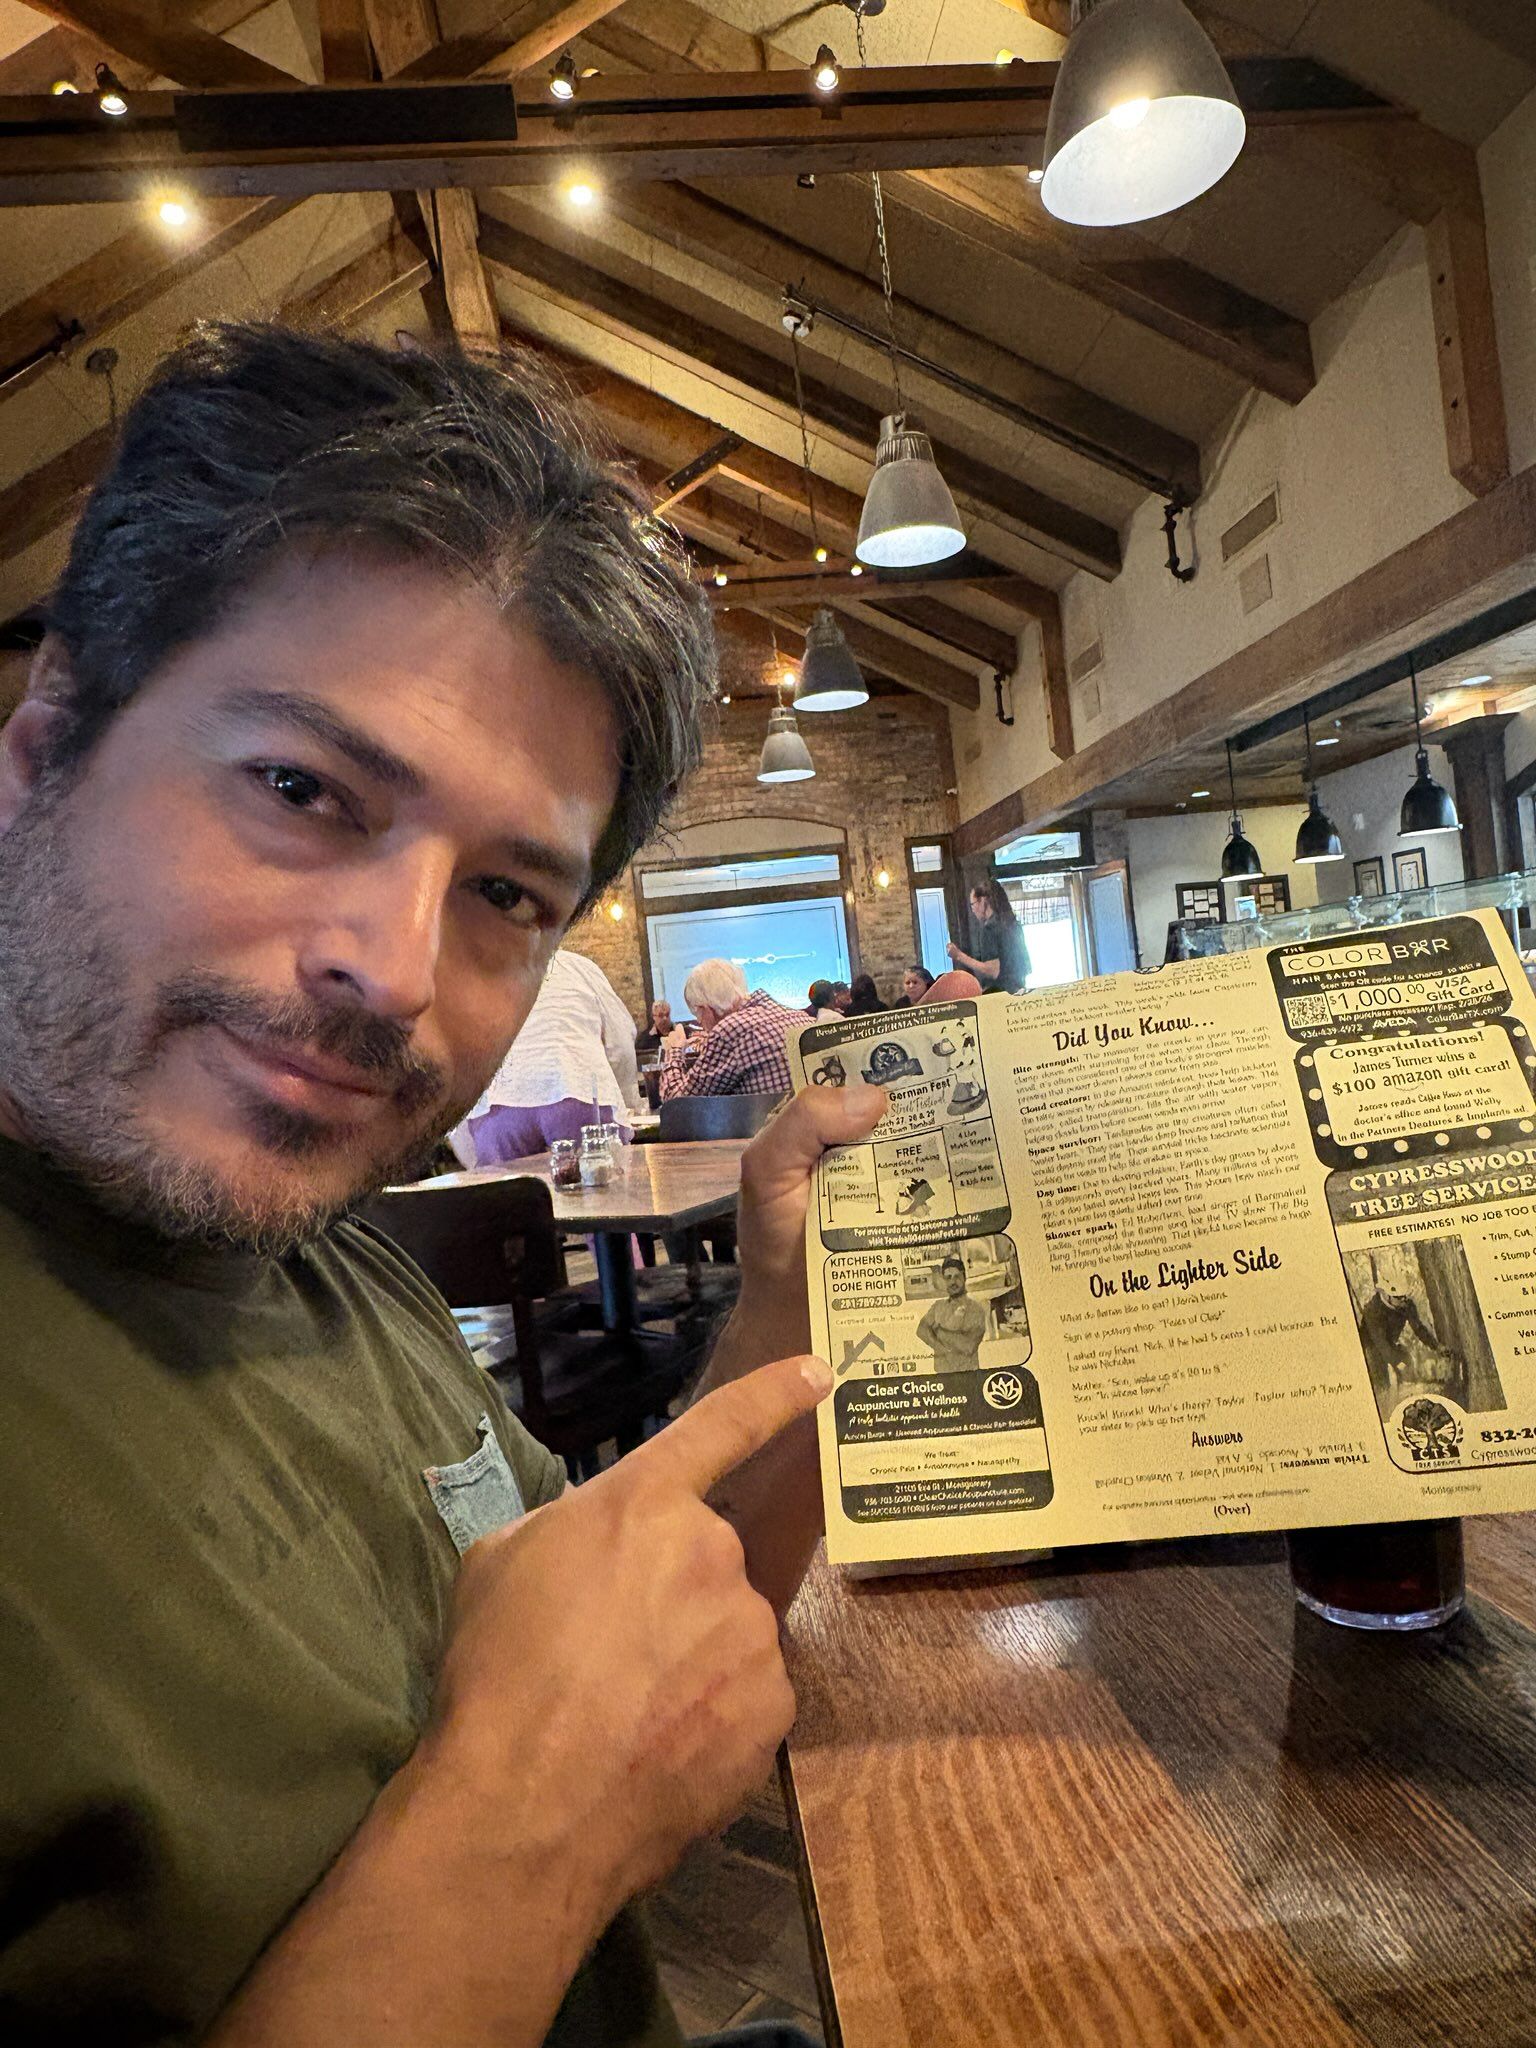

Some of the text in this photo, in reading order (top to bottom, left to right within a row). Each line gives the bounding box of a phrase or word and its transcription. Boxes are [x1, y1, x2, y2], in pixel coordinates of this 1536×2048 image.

[1283, 946, 1305, 955] THE
[1288, 947, 1383, 971] COLOR
[1292, 969, 1366, 985] HAIR SALON
[1320, 981, 1340, 990] Scan
[1356, 977, 1370, 985] QR
[1371, 975, 1392, 984] code
[1435, 975, 1471, 989] VISA
[1426, 980, 1495, 1001] Gift Card
[1338, 1013, 1352, 1022] No
[1354, 1009, 1391, 1022] purchase
[1372, 1016, 1417, 1029] AVEDA
[1052, 1016, 1214, 1051] Did You Know...
[1329, 1030, 1485, 1060] Congratulations!
[1353, 1061, 1391, 1074] James
[1392, 1055, 1433, 1068] Turner
[1436, 1052, 1465, 1063] wins
[1332, 1059, 1511, 1096] $100 amazon gift card!
[889, 1079, 951, 1101] German Fest
[1020, 1095, 1090, 1115] Cloud creators:
[1358, 1102, 1388, 1113] James
[1391, 1097, 1416, 1108] reads
[1476, 1087, 1492, 1095] the
[1354, 1097, 1502, 1126] doctor's office and found Wally
[873, 1118, 935, 1138] Old Town Tomball
[1349, 1131, 1365, 1140] the
[1455, 1114, 1464, 1122] &
[1467, 1108, 1511, 1120] Implants
[896, 1145, 922, 1158] FREE
[1028, 1145, 1055, 1157] Space
[828, 1165, 859, 1173] Vendors
[1037, 1189, 1055, 1200] Day
[1350, 1192, 1418, 1217] TREE
[1368, 1227, 1393, 1239] FREE
[1396, 1217, 1455, 1234] ESTIMATES!
[1461, 1214, 1478, 1224] NO
[1482, 1210, 1503, 1220] JOB
[1504, 1206, 1529, 1217] TOO
[854, 1228, 866, 1237] For
[867, 1227, 886, 1236] more
[1045, 1229, 1082, 1240] Shower
[1489, 1232, 1512, 1241] Trim,
[830, 1255, 893, 1268] KITCHENS &
[1500, 1250, 1531, 1261] Stump
[831, 1267, 901, 1280] BATHROOMS,
[1089, 1246, 1282, 1298] On the Lighter Side
[832, 1279, 897, 1292] DONE RIGHT
[1522, 1287, 1529, 1295] &
[1514, 1346, 1521, 1356] &
[866, 1381, 945, 1396] Clear Choice
[847, 1395, 968, 1413] Acupuncture & Wellness
[1191, 1431, 1243, 1448] Answers
[1334, 1453, 1371, 1465] Trivia
[1420, 1447, 1451, 1460] CTS
[870, 1467, 897, 1475] Chronic
[1213, 1502, 1251, 1518] (Over)
